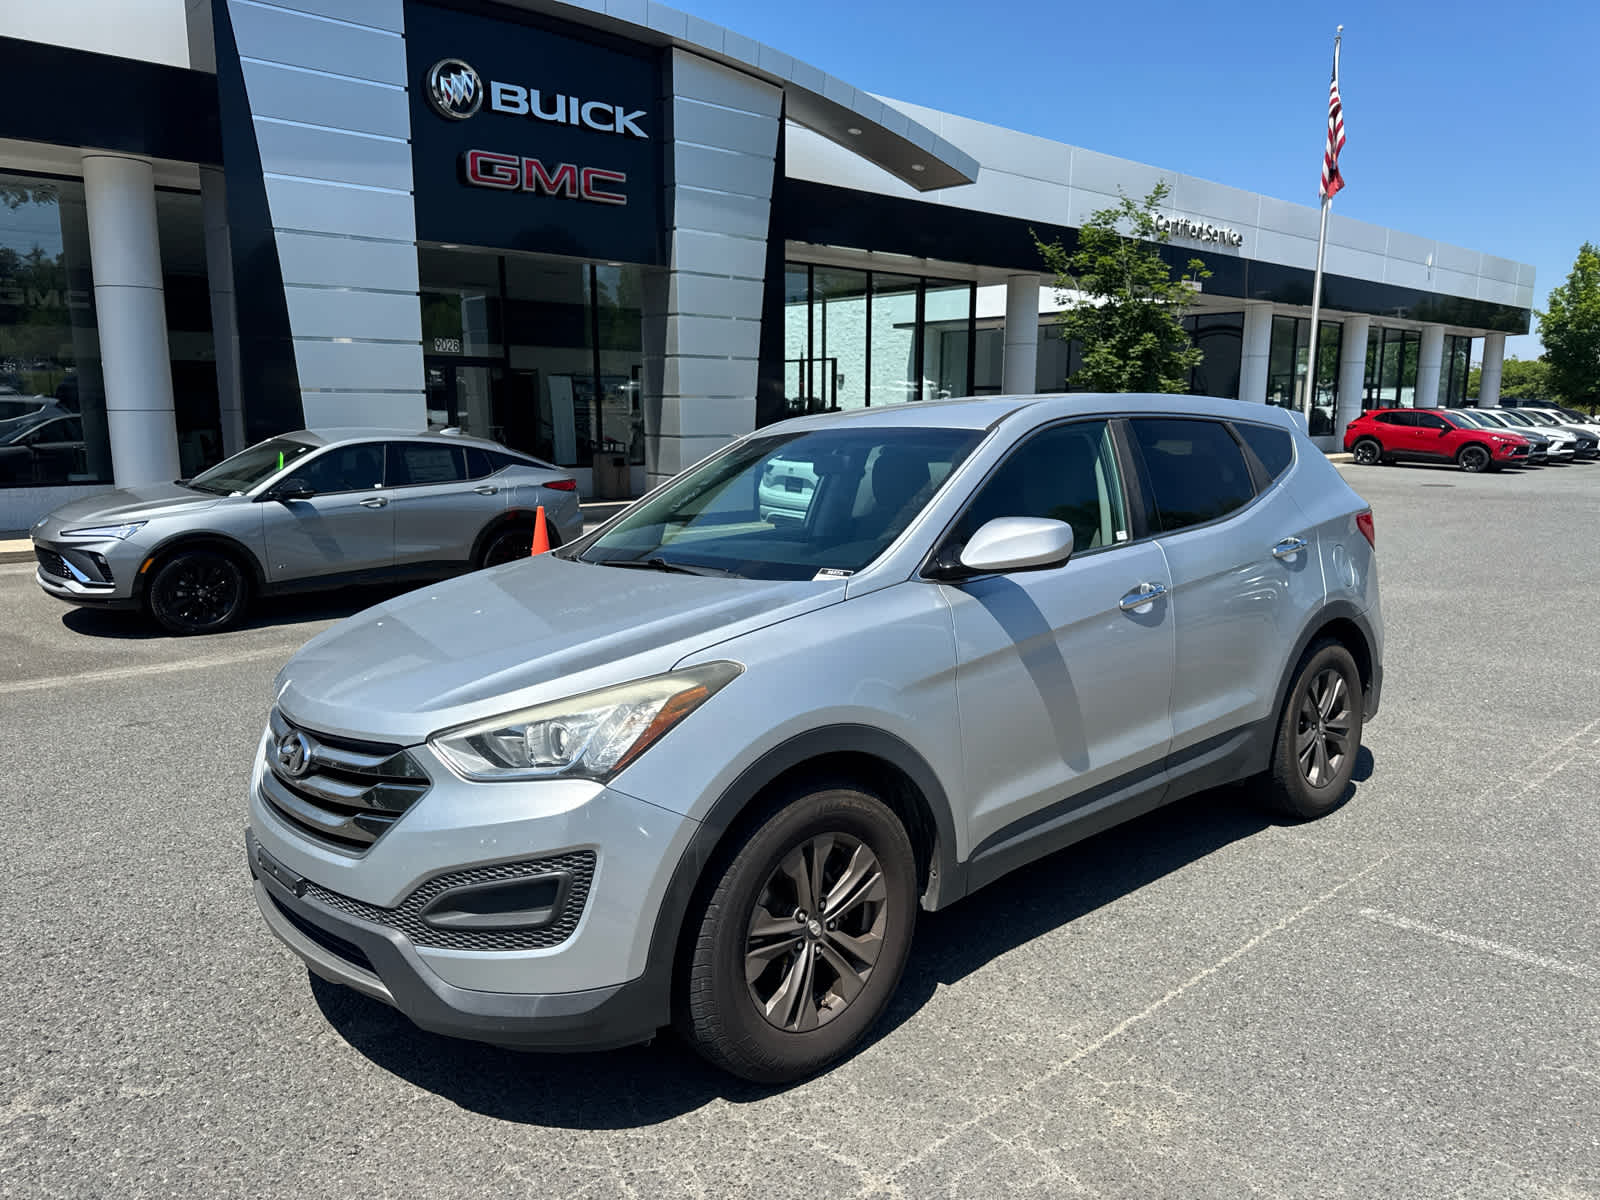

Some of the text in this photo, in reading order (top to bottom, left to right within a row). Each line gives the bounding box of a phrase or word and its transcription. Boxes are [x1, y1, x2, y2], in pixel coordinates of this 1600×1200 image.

[490, 80, 649, 138] BUICK
[465, 149, 627, 205] GMC
[1154, 213, 1243, 248] Certified Service
[434, 338, 460, 352] 9026
